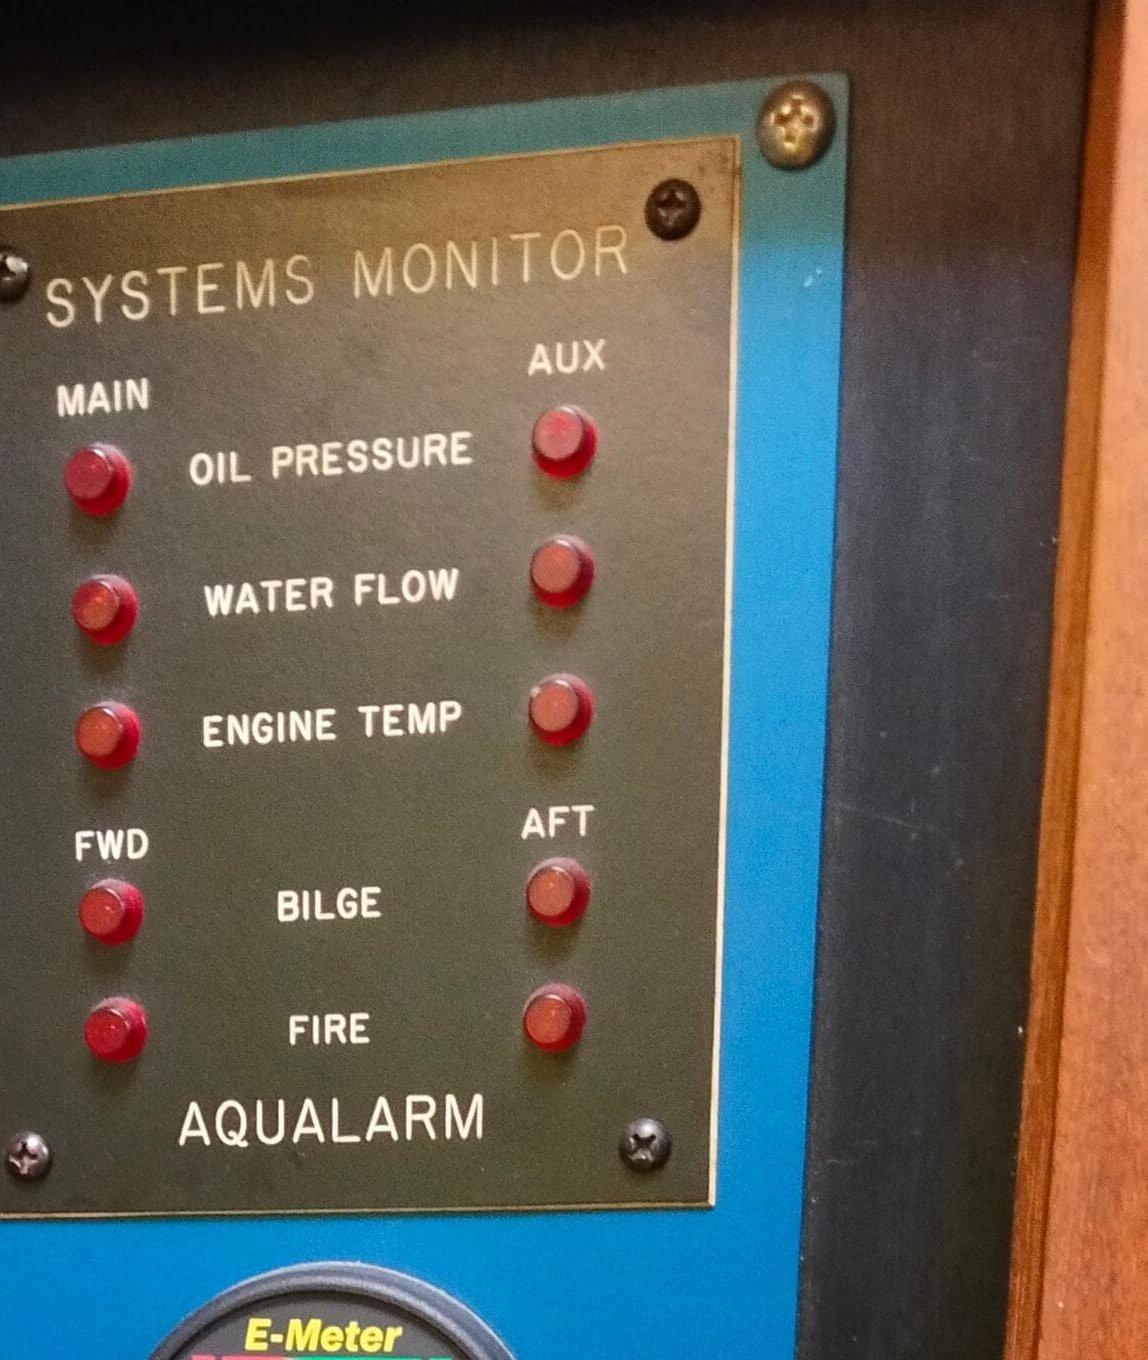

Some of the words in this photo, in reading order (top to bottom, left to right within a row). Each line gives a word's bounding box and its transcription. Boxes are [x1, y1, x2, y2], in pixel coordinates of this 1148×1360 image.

[44, 255, 315, 329] SYSTEMS
[352, 225, 630, 299] MONITOR
[527, 339, 607, 375] AUX
[56, 379, 150, 416] MAIN
[189, 452, 251, 486] OIL
[272, 431, 473, 478] PRESSURE
[204, 578, 333, 617] WATER
[353, 569, 459, 607] FLOW
[202, 709, 336, 748] ENGINE
[359, 700, 462, 737] TEMP
[521, 805, 595, 840] AFT
[74, 829, 150, 862] FWD
[277, 888, 382, 923] BILGE
[289, 1013, 370, 1046] FIRE
[179, 1092, 484, 1148] AQUALARM
[245, 1318, 403, 1353] E-Meter
